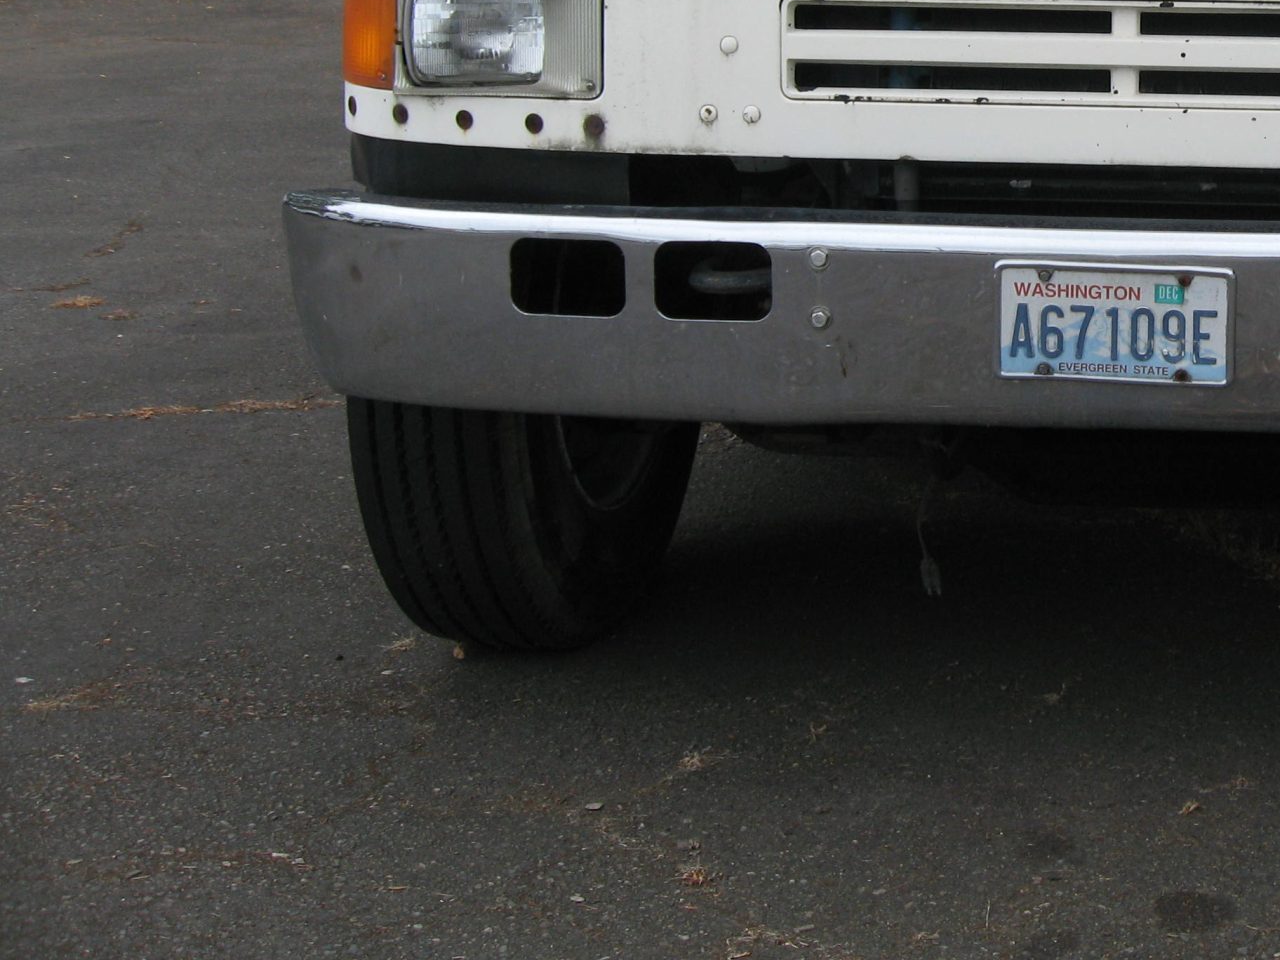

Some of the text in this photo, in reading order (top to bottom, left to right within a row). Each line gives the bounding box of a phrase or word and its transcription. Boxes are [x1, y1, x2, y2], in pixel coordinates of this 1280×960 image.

[1013, 281, 1142, 302] WASHINGTON
[1159, 285, 1179, 300] DEC
[1009, 302, 1219, 366] A67109E
[1058, 362, 1169, 376] EVERGREEN STATE
